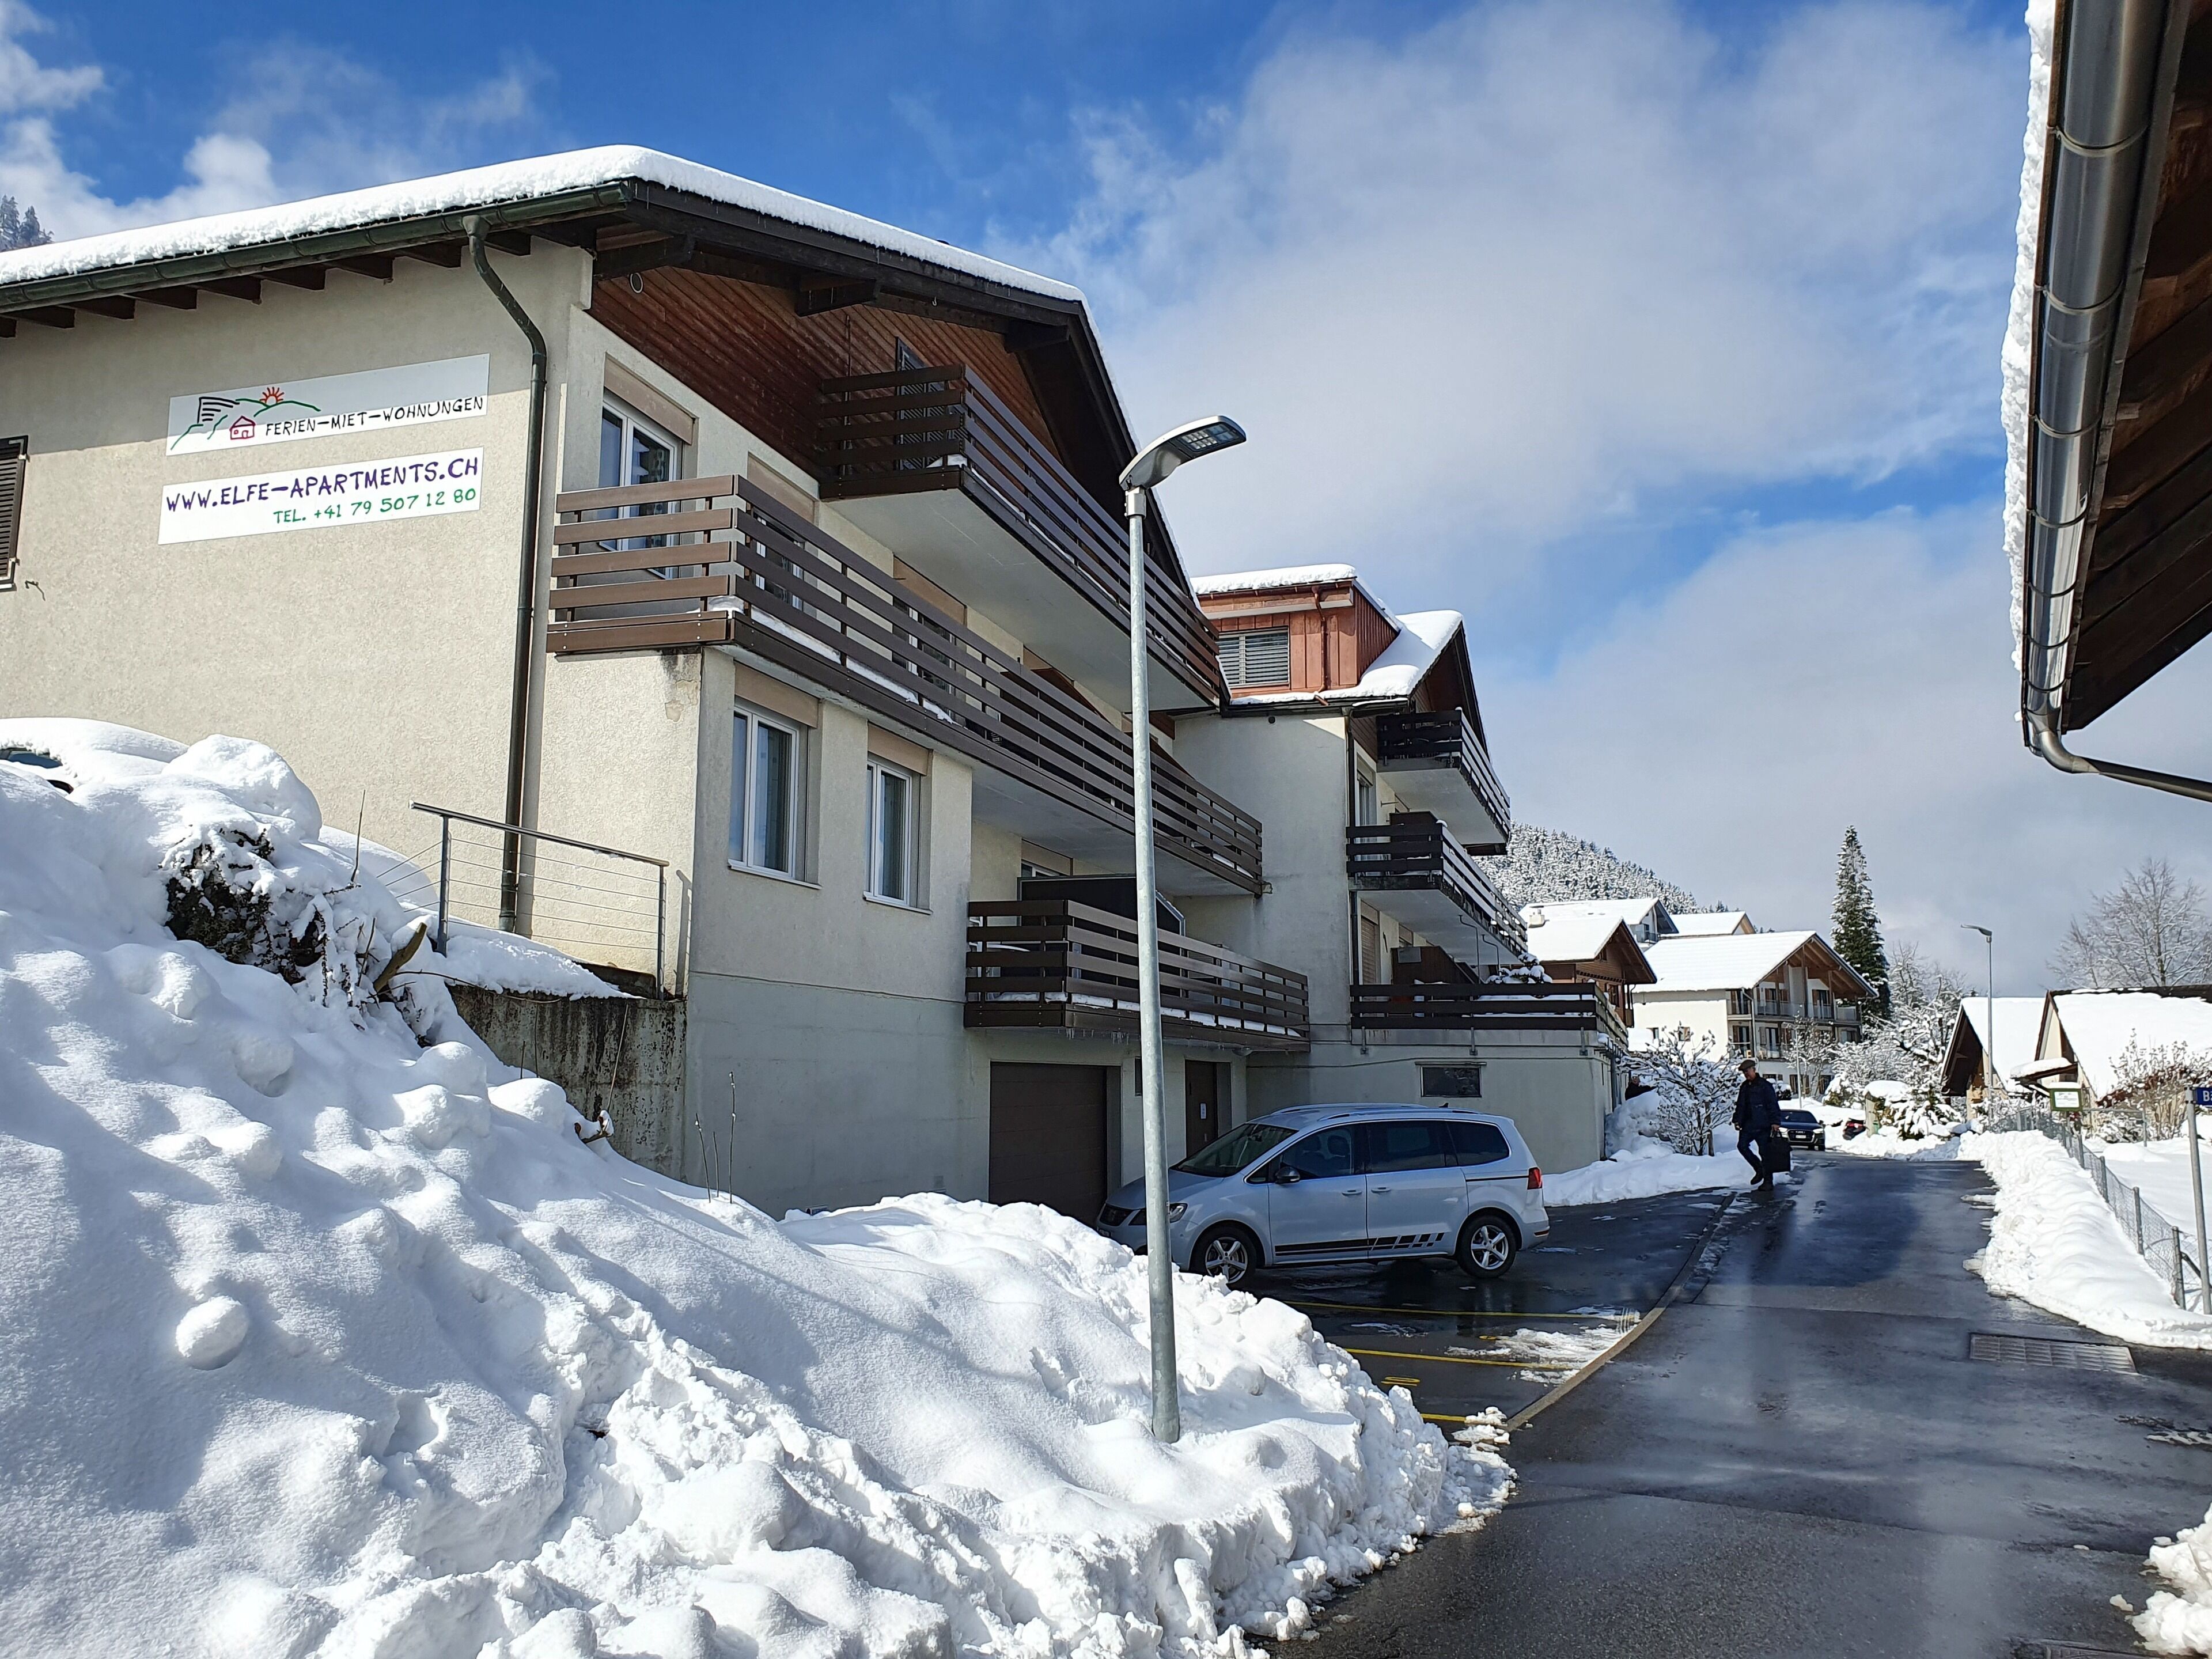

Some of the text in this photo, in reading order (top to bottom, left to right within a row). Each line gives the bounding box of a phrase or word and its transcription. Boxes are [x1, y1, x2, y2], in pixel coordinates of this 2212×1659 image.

[266, 396, 483, 437] FERIEN-MIET-WOHNUNGEN
[166, 457, 478, 512] WWW.ELFE-APARTMENTS.CH
[273, 487, 476, 524] TEL. +41 79 507 12 80
